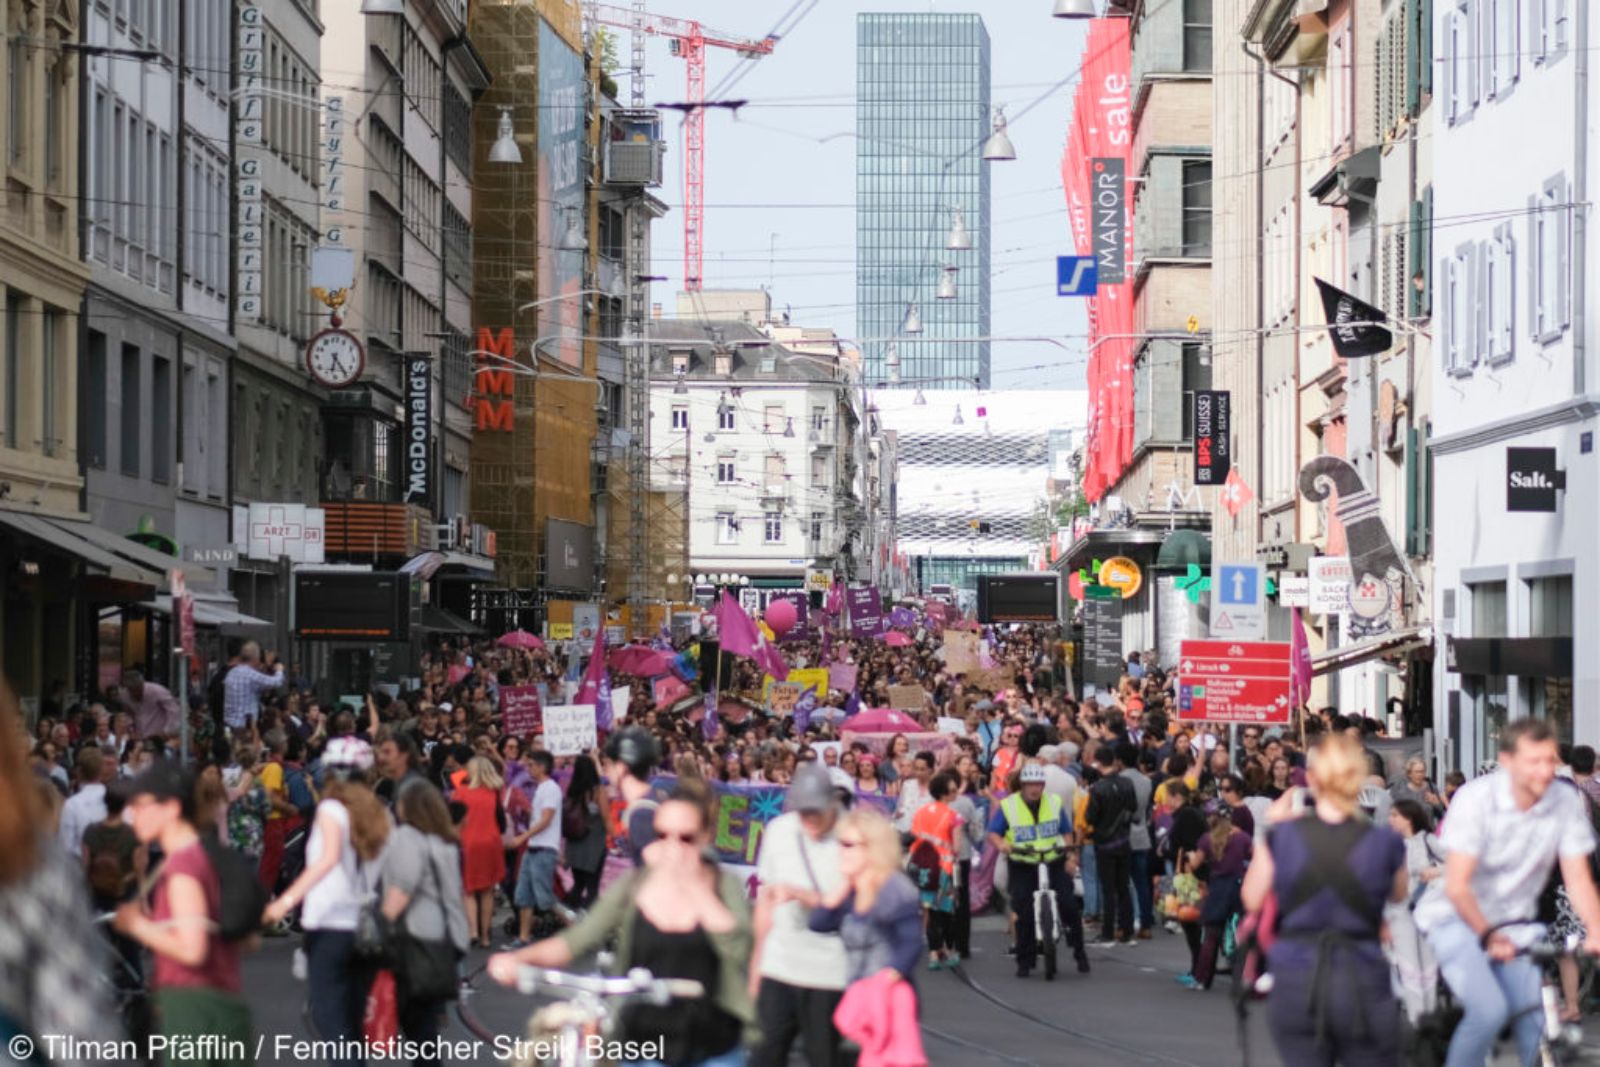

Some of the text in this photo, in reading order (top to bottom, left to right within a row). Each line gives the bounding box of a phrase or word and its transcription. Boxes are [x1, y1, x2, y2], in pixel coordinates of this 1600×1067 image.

[1099, 73, 1128, 145] sale
[241, 160, 258, 312] Galerie
[1098, 173, 1119, 269] MANOR
[409, 360, 427, 493] McDonald's
[1197, 394, 1212, 466] BPS (SUISSE)
[1510, 471, 1553, 488] Salt.
[193, 549, 235, 561] KIND
[263, 527, 291, 536] ARZT
